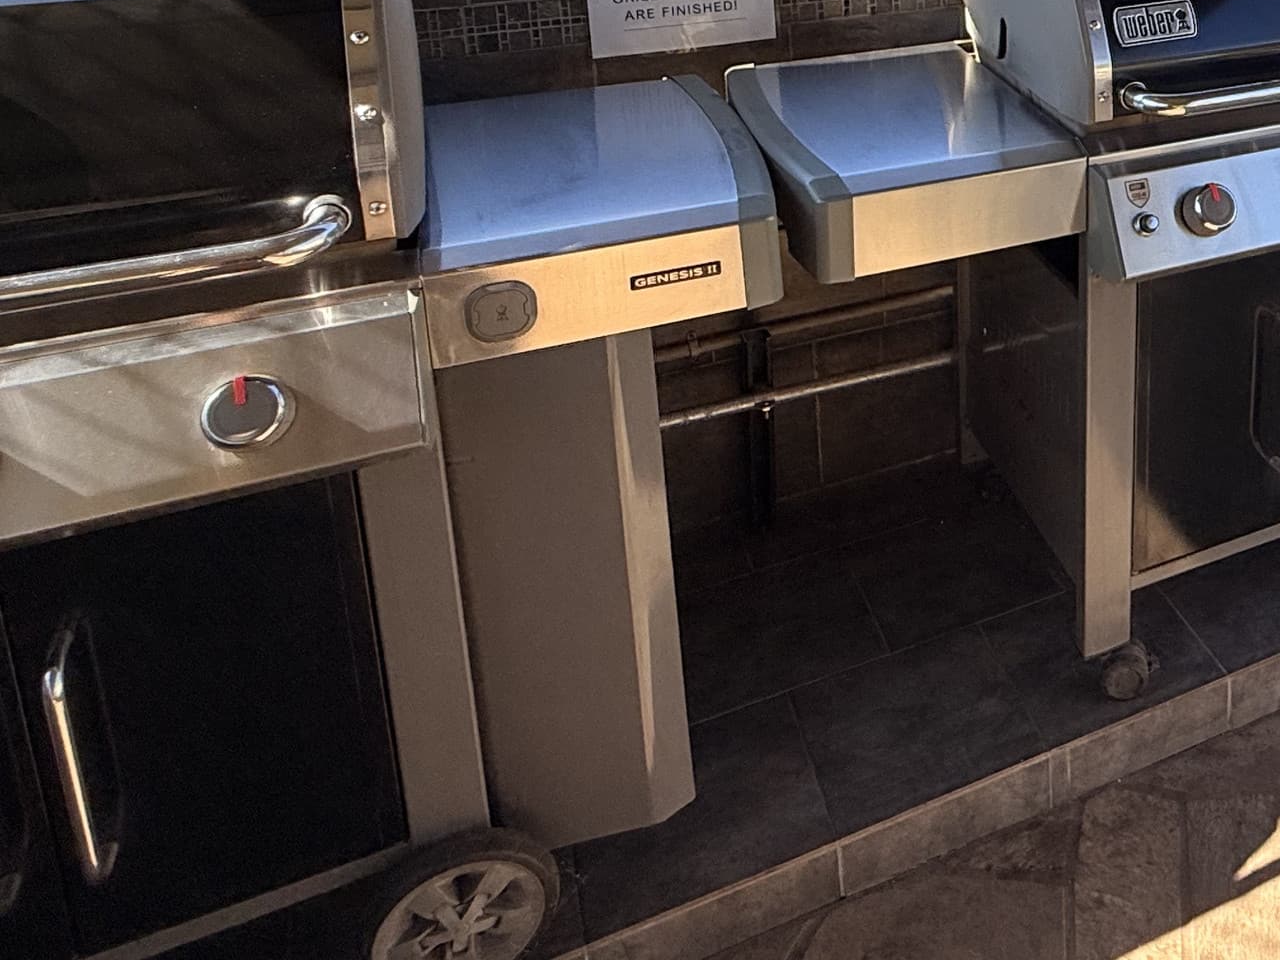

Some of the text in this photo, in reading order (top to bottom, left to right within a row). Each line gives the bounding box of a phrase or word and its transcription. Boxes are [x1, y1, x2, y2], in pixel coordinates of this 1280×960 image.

[624, 0, 738, 22] ARE FINISHED!
[1121, 7, 1175, 39] weber
[634, 264, 718, 287] GENESIS II
